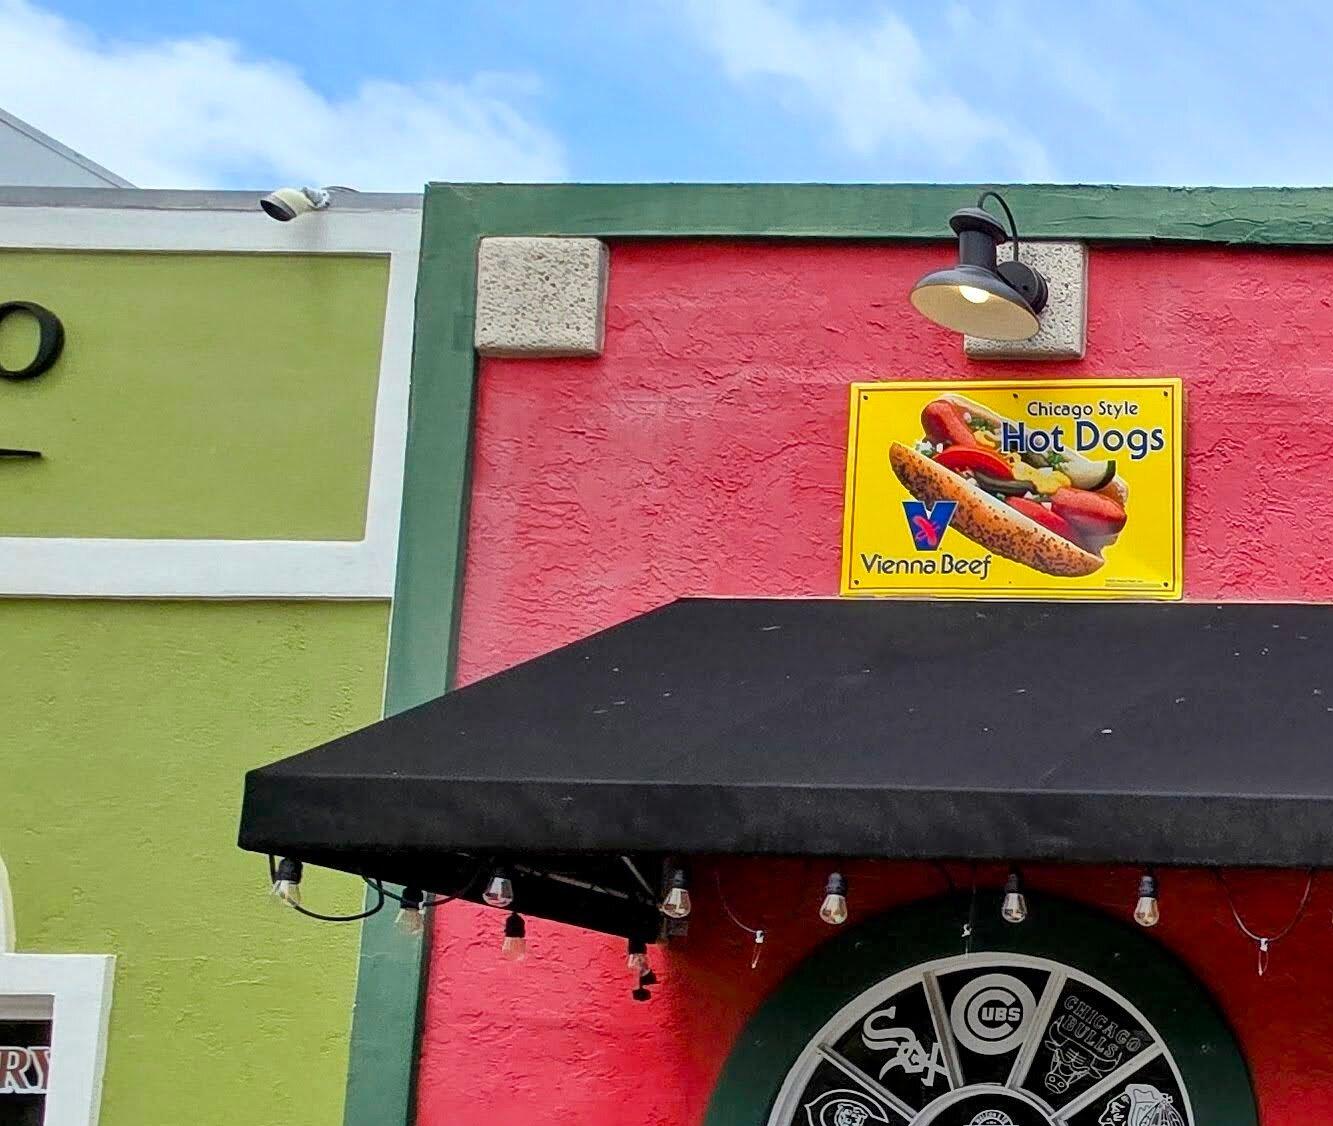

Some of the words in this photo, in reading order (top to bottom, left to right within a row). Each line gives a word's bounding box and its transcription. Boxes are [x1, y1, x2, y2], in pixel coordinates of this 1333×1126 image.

[1028, 402, 1094, 419] Chicago
[1099, 401, 1138, 416] Style
[1002, 421, 1064, 452] Hot
[1076, 420, 1164, 459] Dogs
[861, 554, 937, 575] Vienna
[941, 554, 992, 580] Beef
[1062, 1015, 1119, 1058] BULLS
[1064, 995, 1141, 1052] CHICAGO
